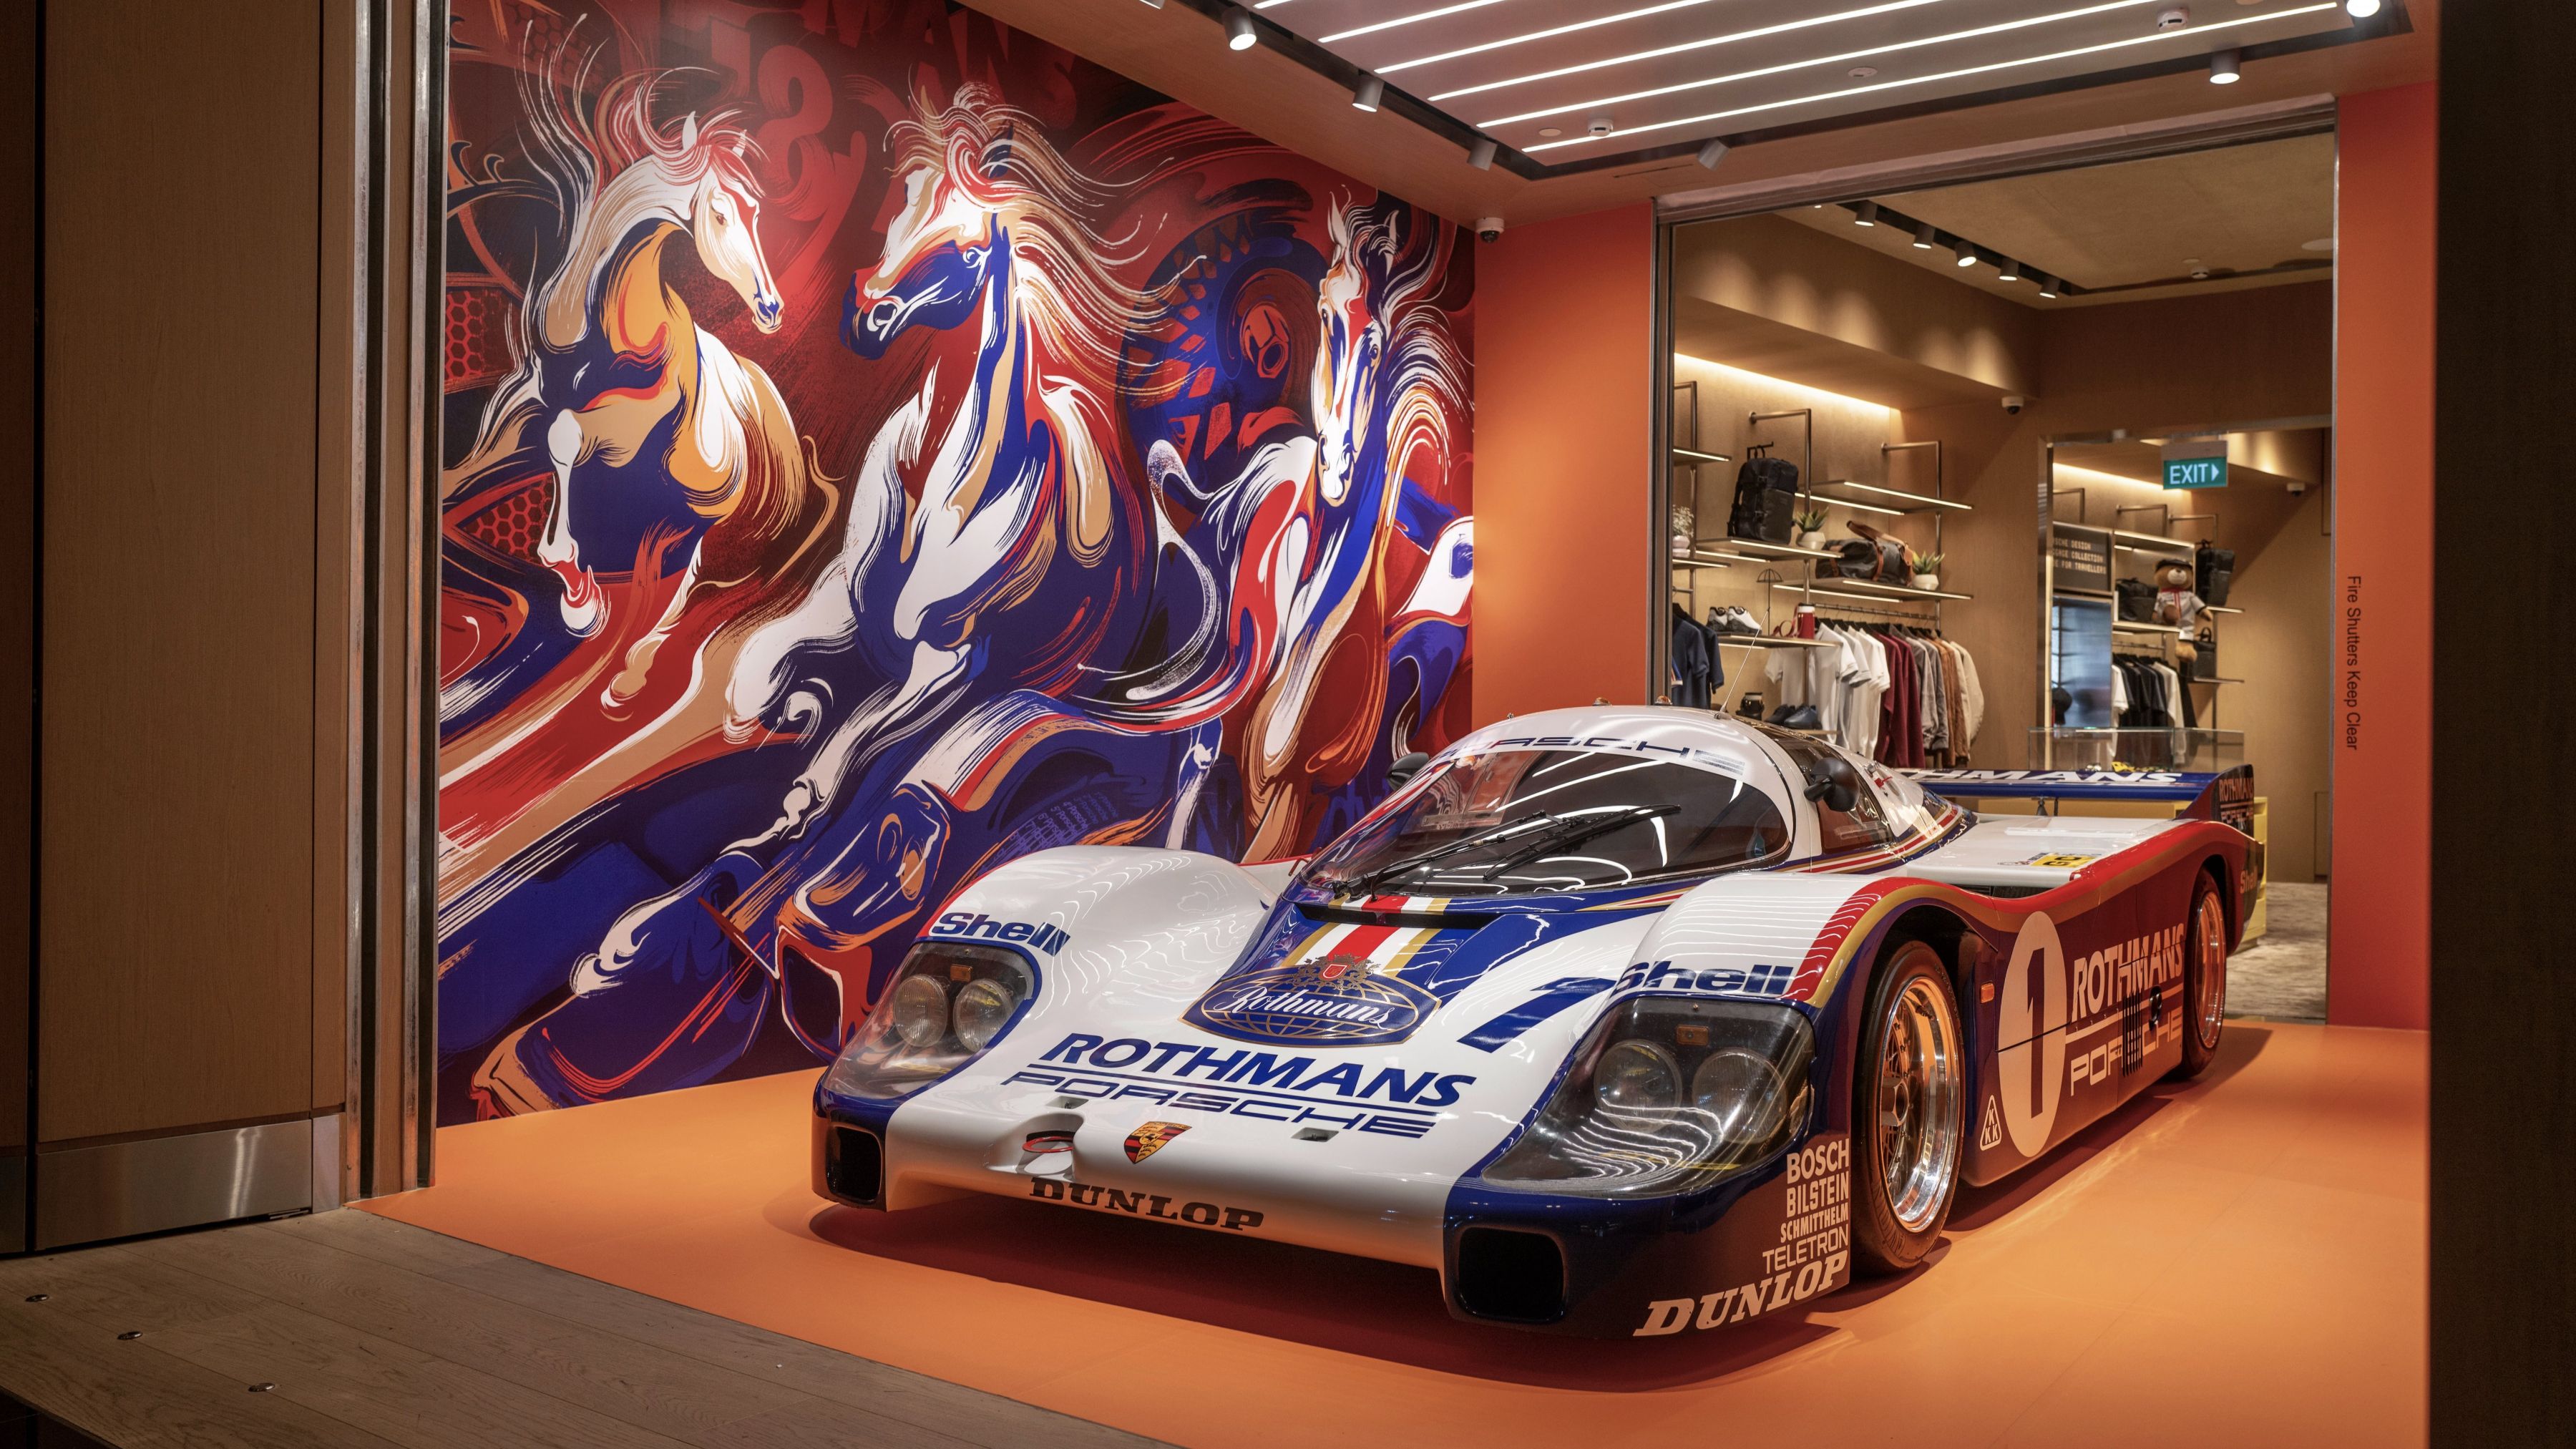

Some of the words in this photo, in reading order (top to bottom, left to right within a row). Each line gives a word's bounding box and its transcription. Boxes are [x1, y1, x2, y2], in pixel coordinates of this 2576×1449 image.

[2170, 463, 2209, 484] EXIT
[2347, 575, 2361, 602] Fire
[2346, 608, 2361, 666] Shutters
[2343, 670, 2361, 708] Keep
[2346, 712, 2361, 751] Clear
[1900, 768, 2182, 784] HMANS
[931, 912, 1071, 957] Shell
[1610, 960, 1794, 997] Shell
[2072, 923, 2185, 1023] ROTHMANS
[1214, 986, 1395, 1030] Rothmans
[2026, 947, 2045, 1119] 1
[1045, 1032, 1477, 1107] ROTHMANS
[1002, 1071, 1437, 1138] PORSCHE
[1786, 1138, 1850, 1184] BOSCH
[1028, 1176, 1264, 1231] DUNLOP
[1786, 1171, 1849, 1218] BILSTEIN
[1780, 1202, 1849, 1244] SCHMITTHELM
[1762, 1224, 1848, 1274] TELETRON
[1632, 1249, 1848, 1337] DUNLOP
